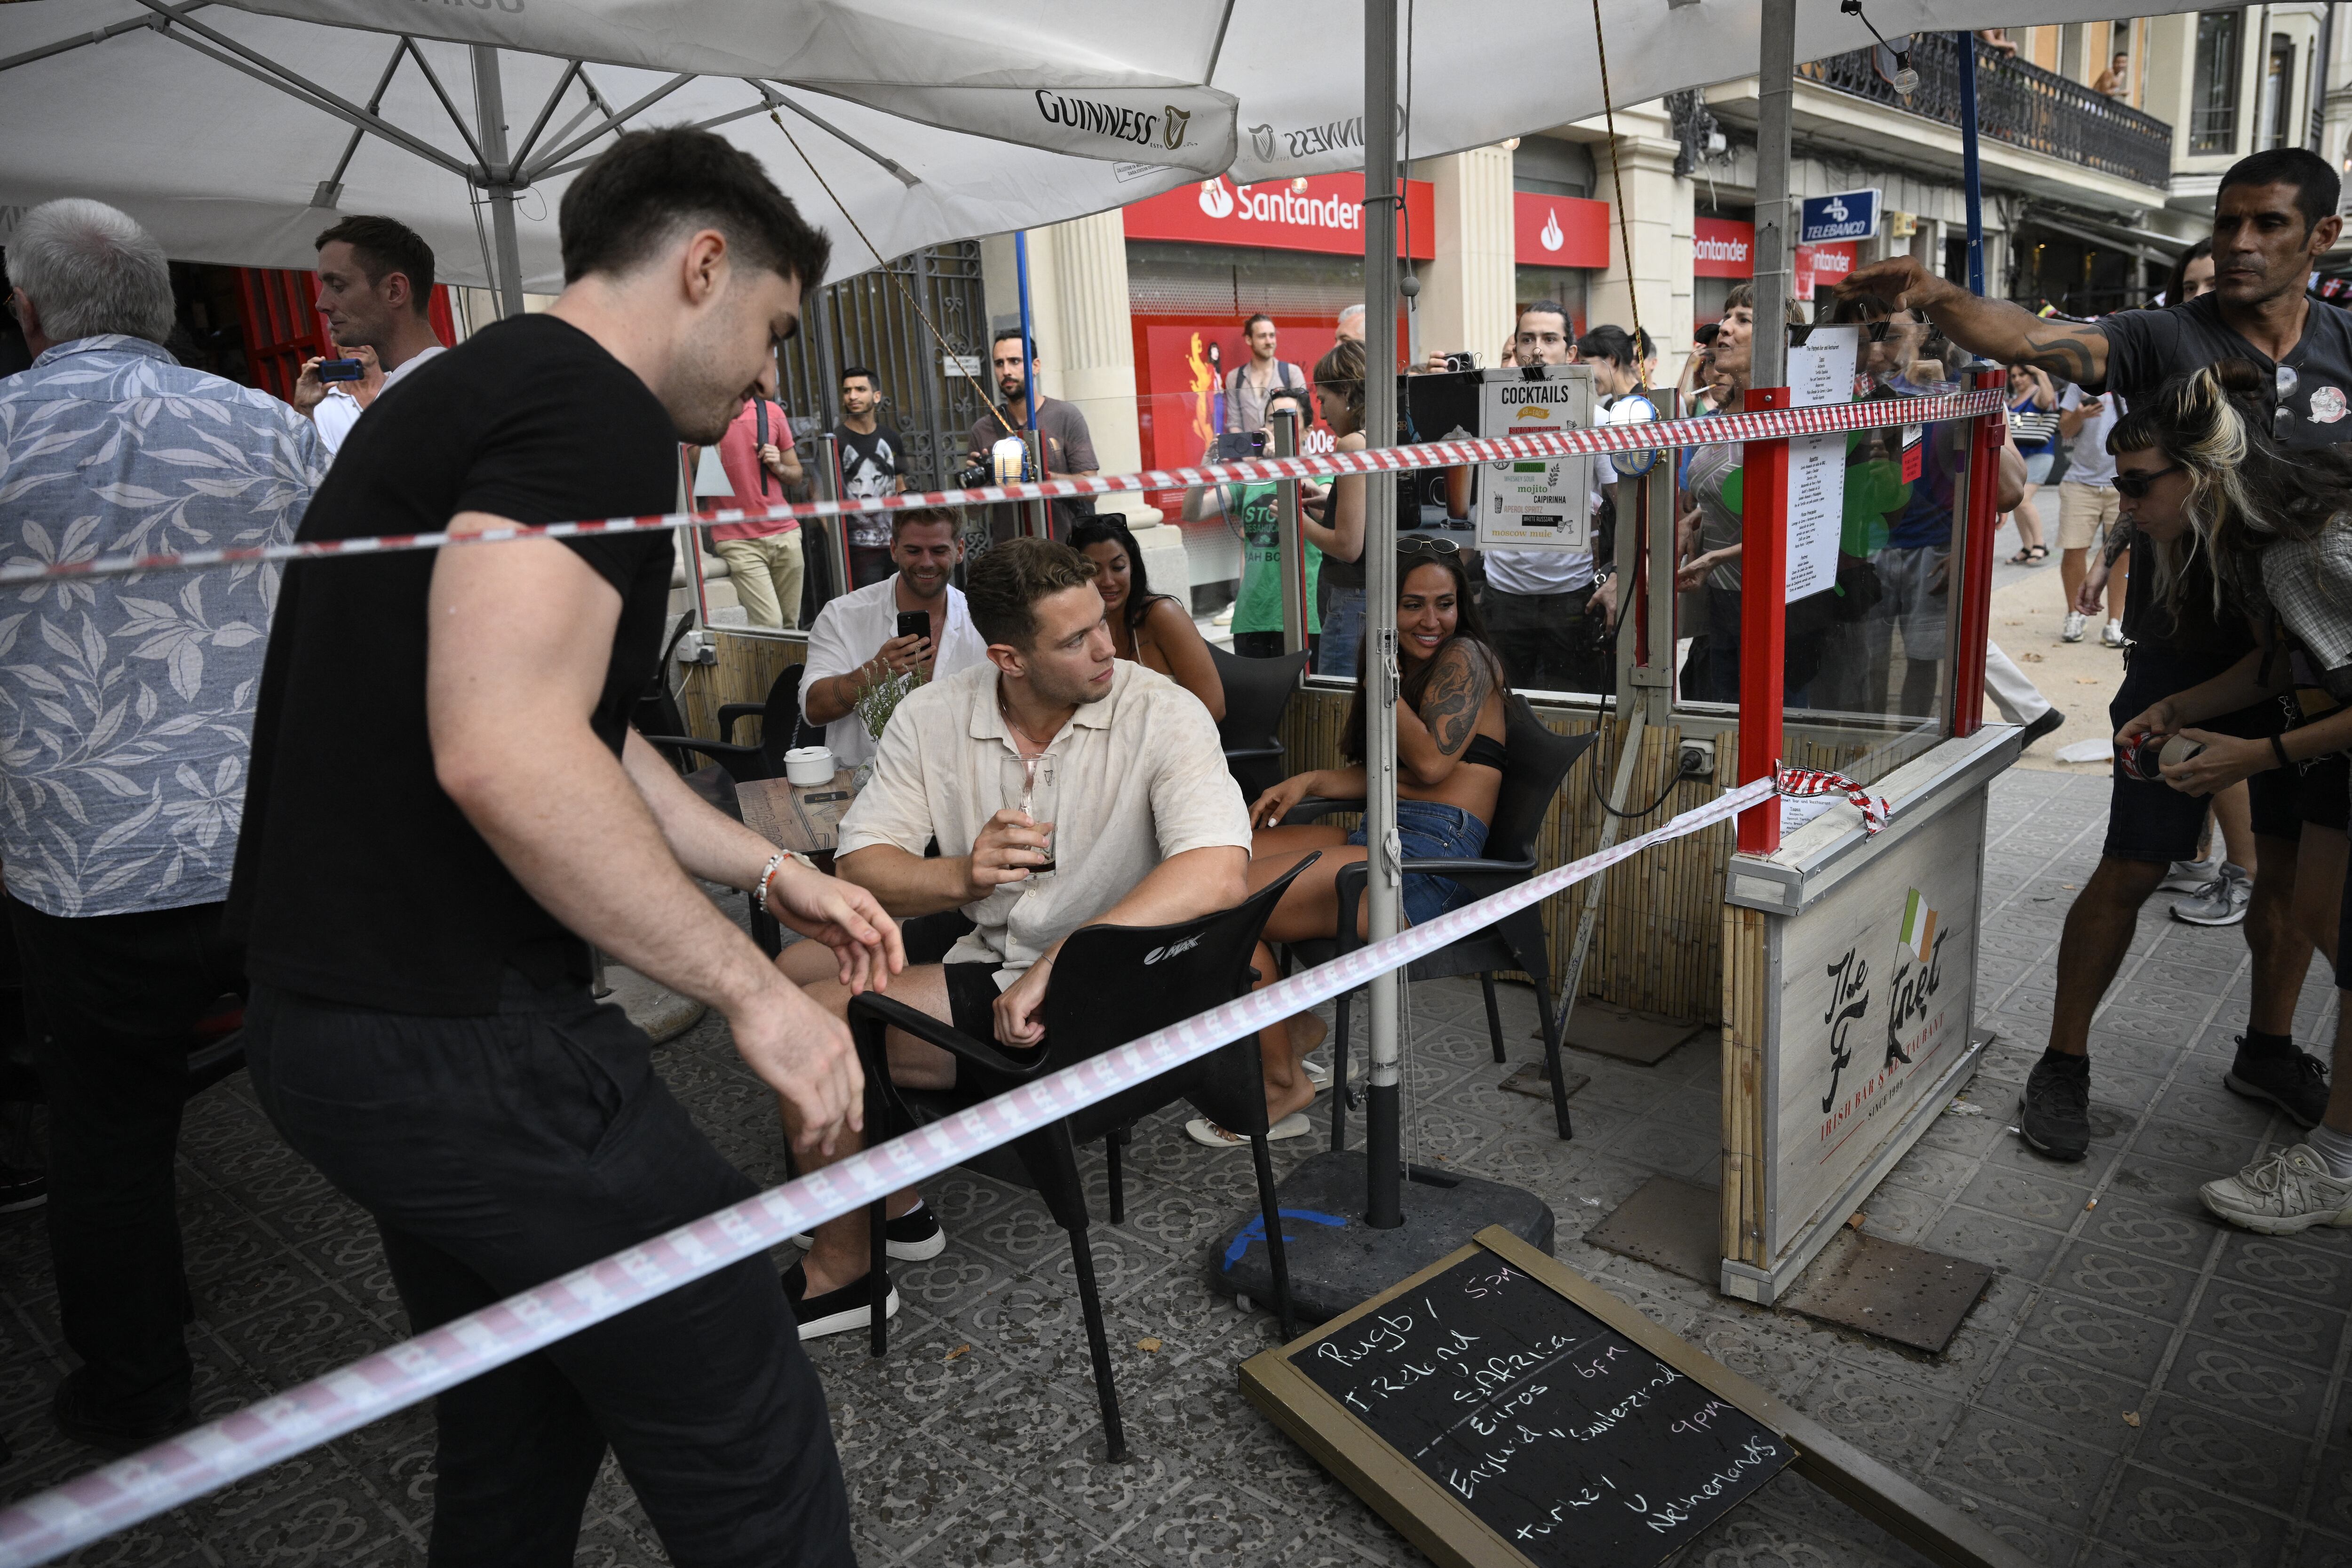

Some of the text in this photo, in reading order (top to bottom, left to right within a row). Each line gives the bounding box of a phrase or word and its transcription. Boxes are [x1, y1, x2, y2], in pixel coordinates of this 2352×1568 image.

[1035, 89, 1157, 144] GUINNESS
[1238, 184, 1362, 230] Santander
[1807, 220, 1866, 239] TELEBANCO
[1814, 249, 1850, 272] ntander
[1502, 385, 1568, 405] COCKTAILS
[1518, 485, 1548, 494] mojito
[1534, 495, 1566, 504] CAIPIRINHA
[1245, 507, 1276, 523] STO
[1245, 524, 1279, 533] DESAHUCI
[1162, 932, 1206, 961] MAX
[1825, 947, 1869, 1025] The
[1820, 1011, 1944, 1142] IRISH BAR & RETAURANT
[1868, 1078, 1903, 1121] SINCE 1999
